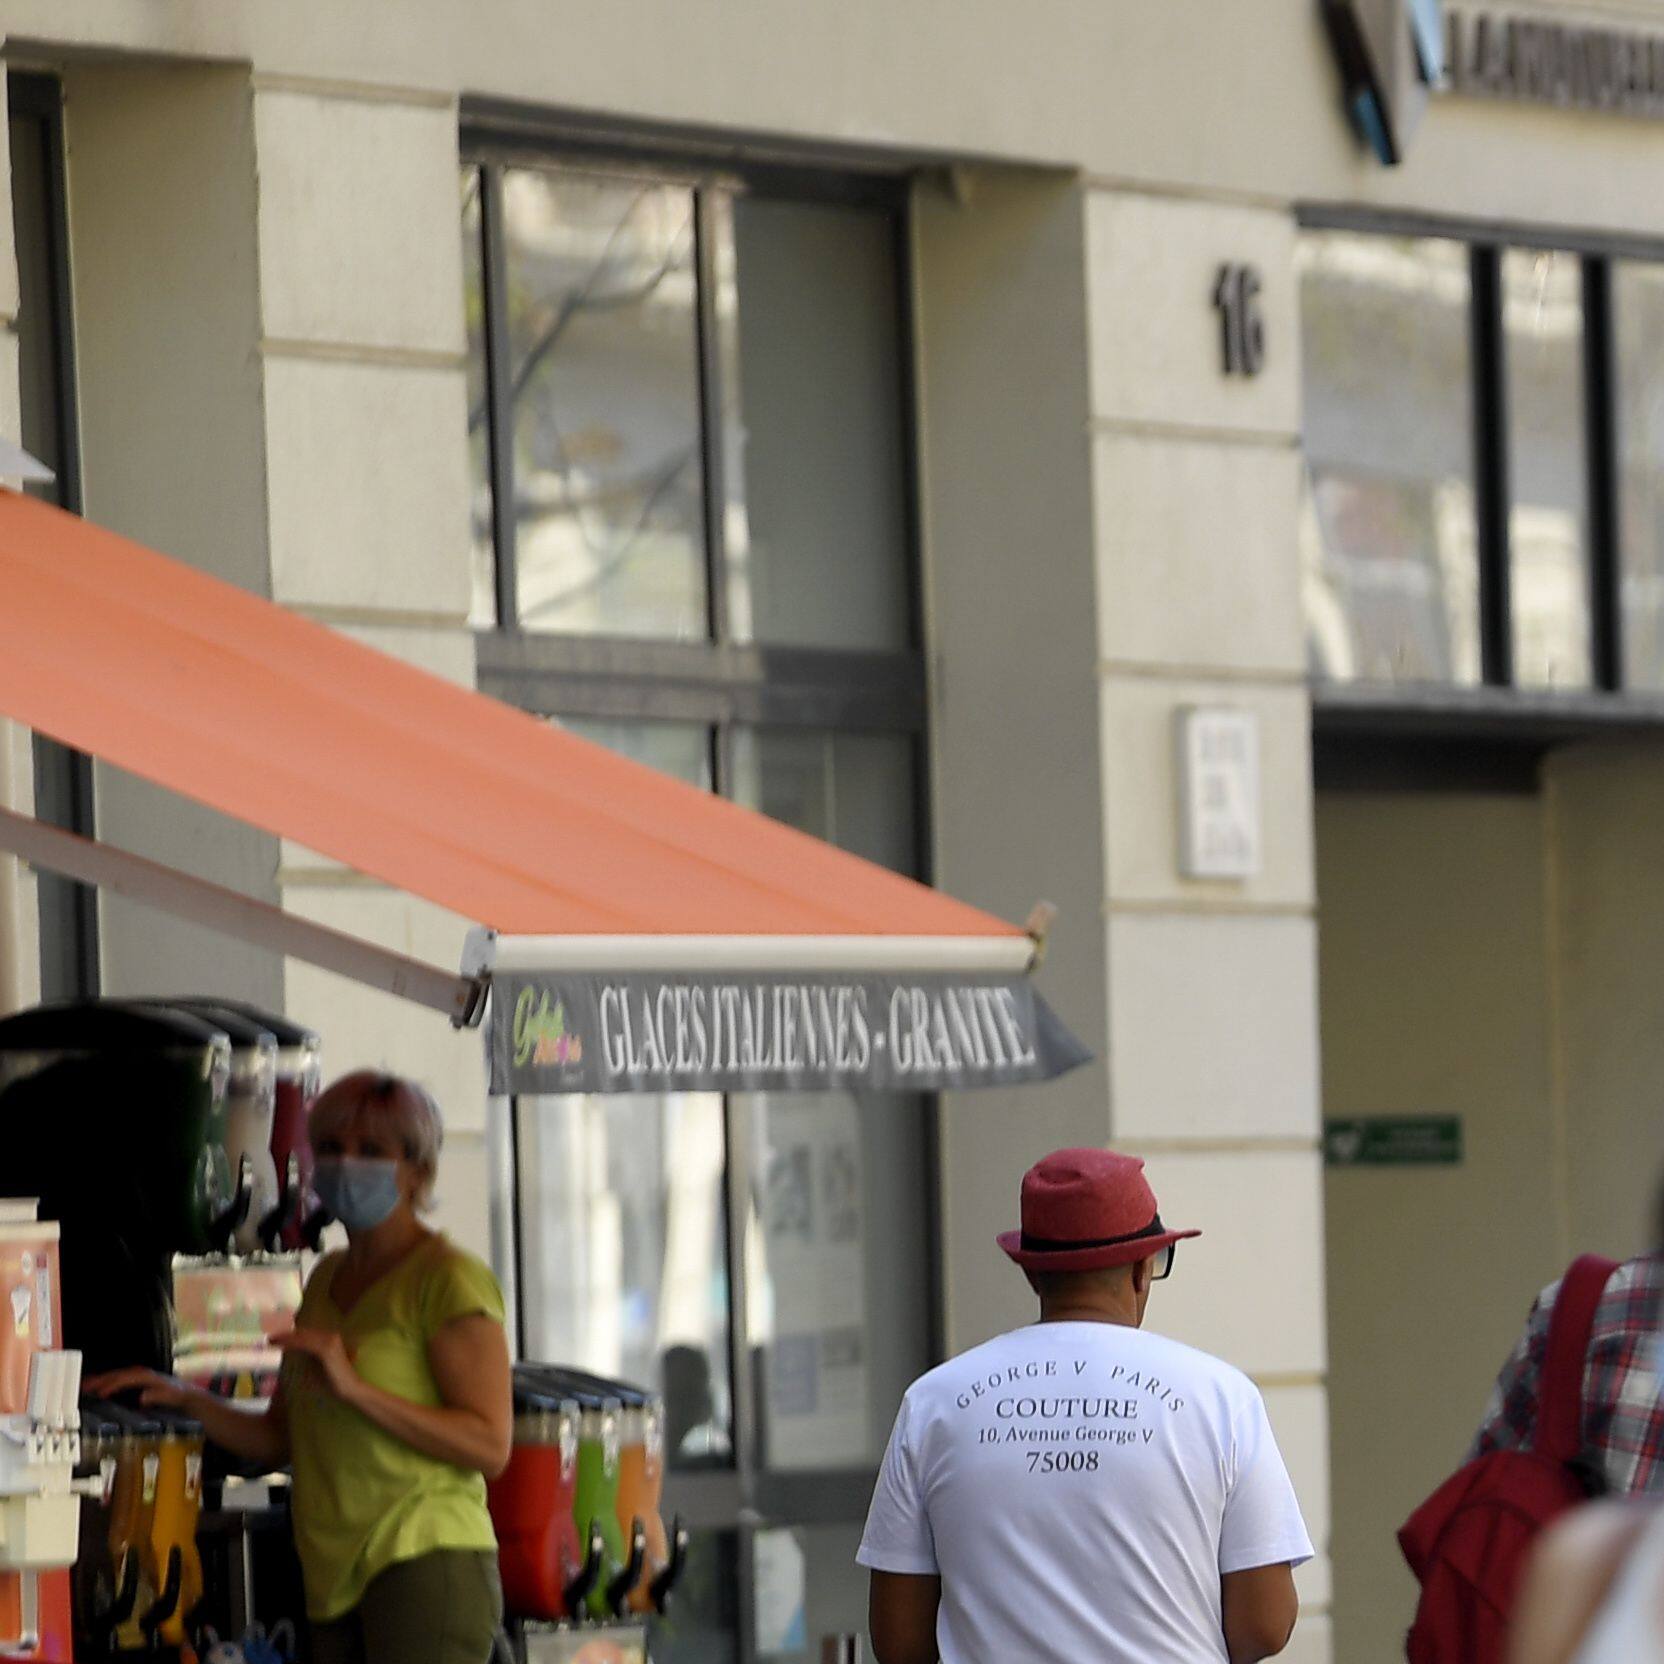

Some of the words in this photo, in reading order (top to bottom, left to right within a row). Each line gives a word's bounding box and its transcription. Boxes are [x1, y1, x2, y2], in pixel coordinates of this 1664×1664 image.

[1212, 263, 1263, 376] 16
[601, 985, 707, 1074] GLACES
[711, 985, 869, 1071] ITALIENNES
[956, 1360, 1057, 1410] GEORGE
[1073, 1361, 1087, 1376] V
[1111, 1365, 1185, 1412] PARIS
[996, 1397, 1138, 1420] COUTURE
[978, 1427, 1001, 1444] 10,
[1005, 1426, 1071, 1442] Avenue
[1075, 1425, 1137, 1445] George
[1141, 1428, 1154, 1445] V
[1026, 1451, 1099, 1474] 75008
